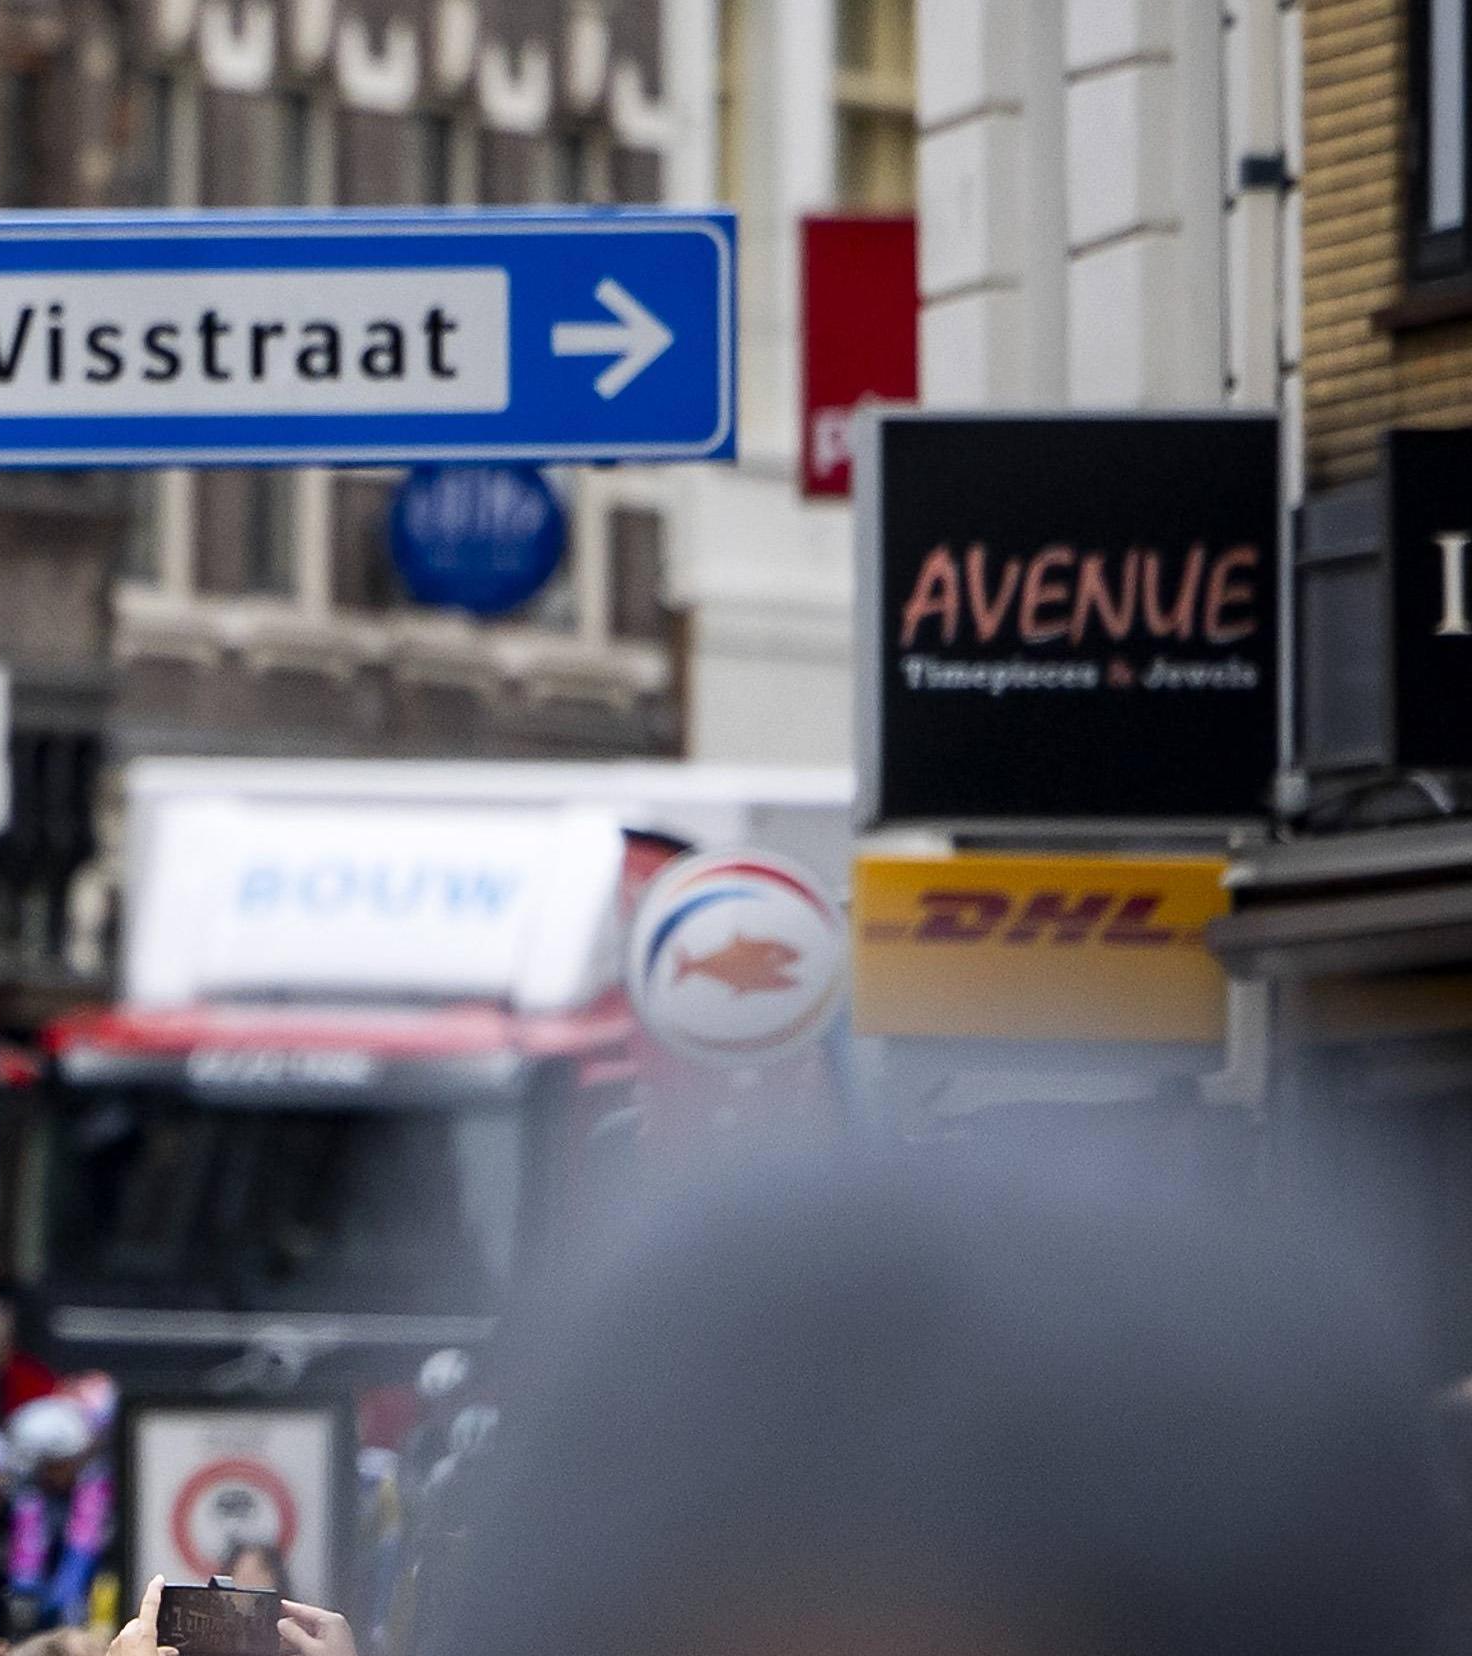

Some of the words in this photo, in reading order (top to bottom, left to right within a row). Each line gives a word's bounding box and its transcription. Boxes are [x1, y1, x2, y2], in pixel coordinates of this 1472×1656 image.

[900, 541, 1260, 648] AVENUE
[900, 655, 1099, 696] Timepieces
[1143, 655, 1259, 690] Jewels
[917, 890, 1172, 943] DHL
